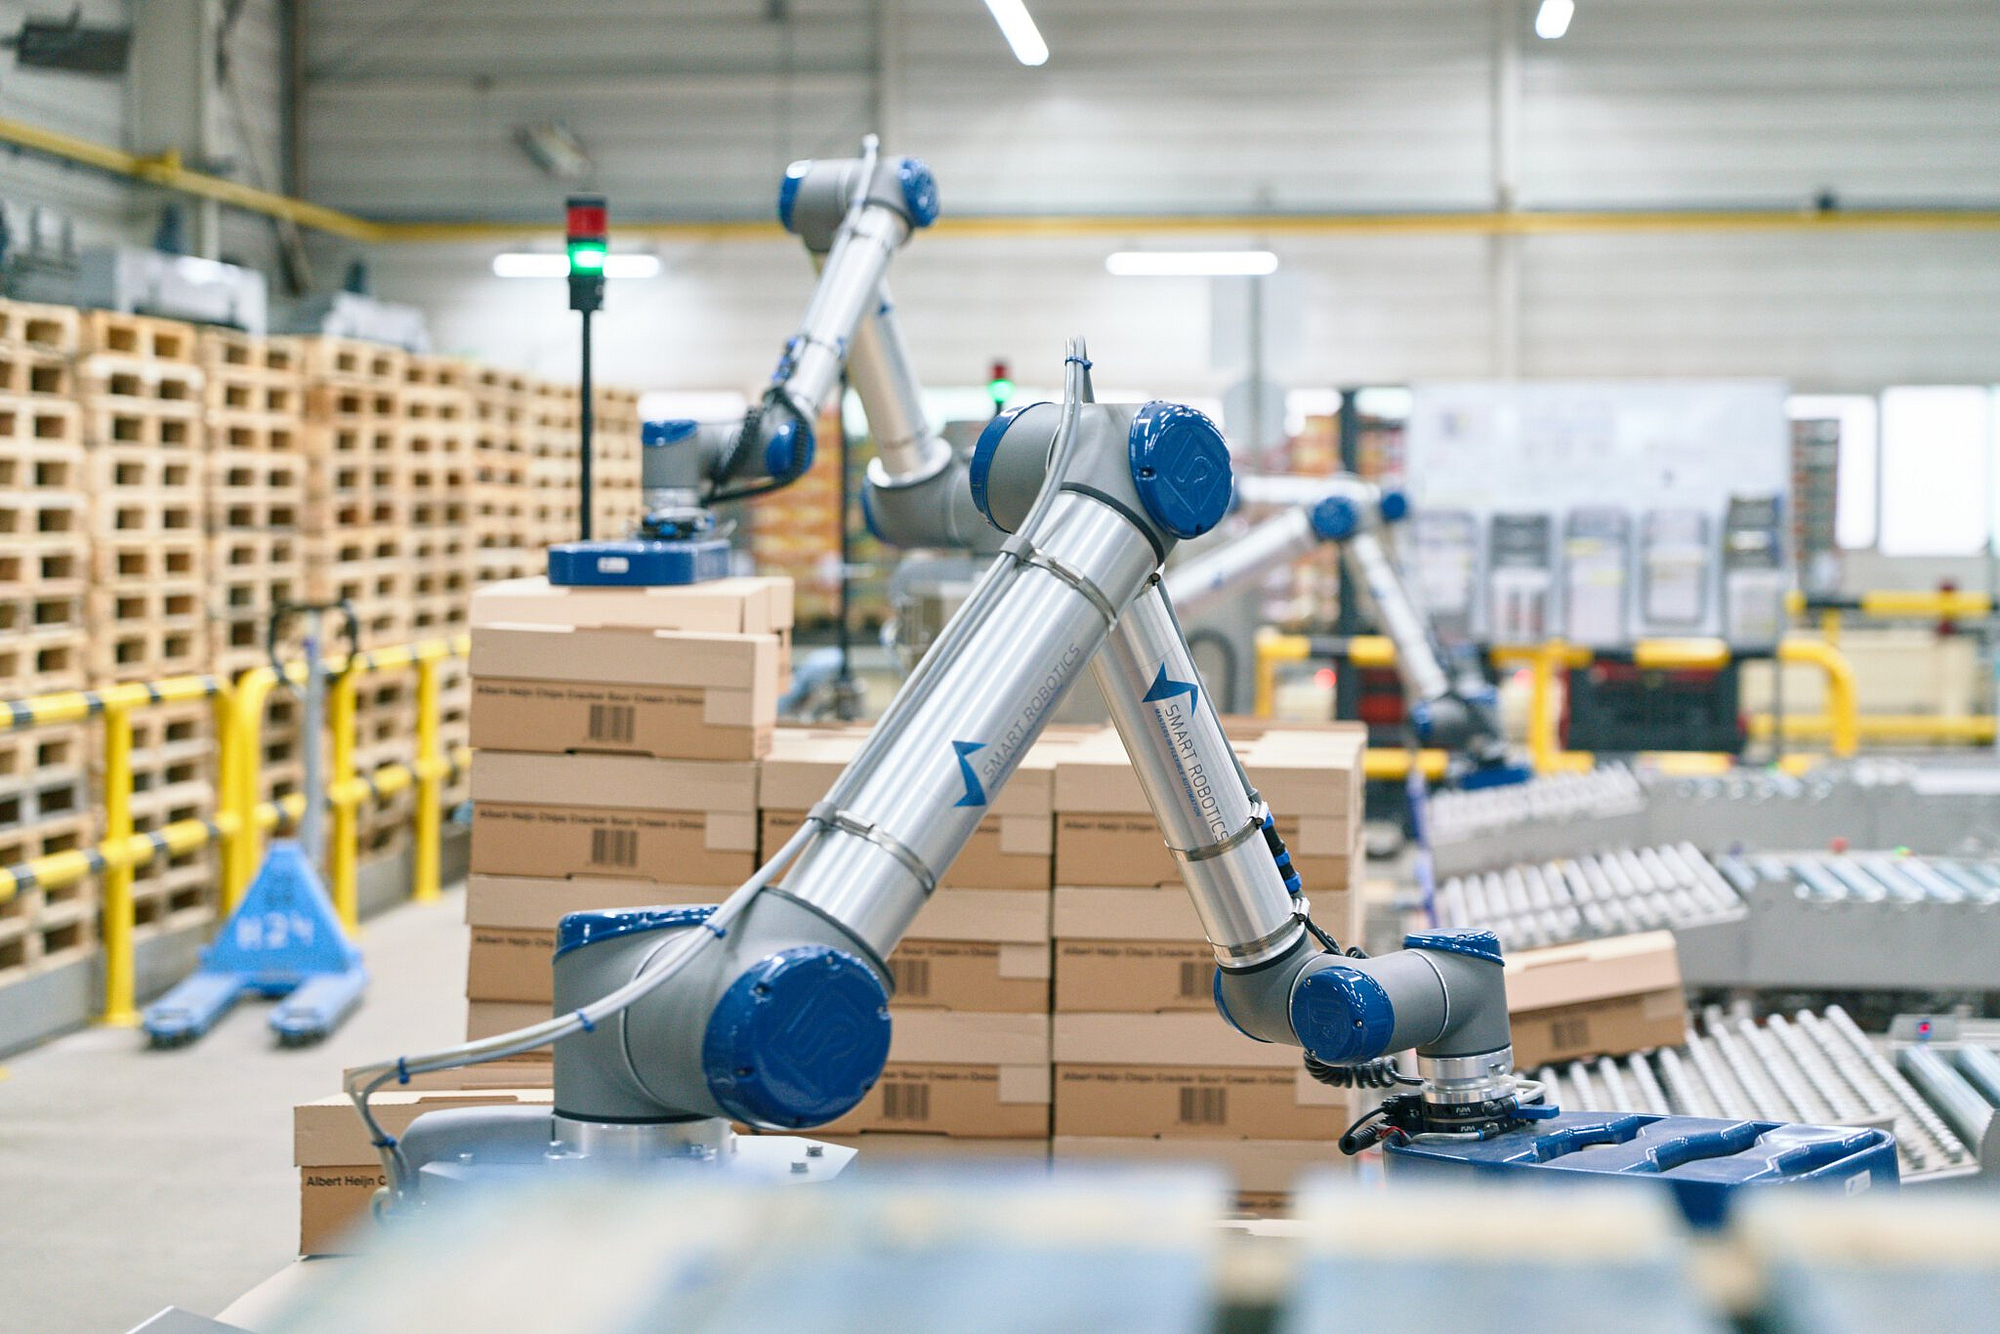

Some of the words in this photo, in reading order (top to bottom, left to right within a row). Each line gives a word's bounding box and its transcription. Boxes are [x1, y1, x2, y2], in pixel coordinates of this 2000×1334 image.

[984, 719, 1025, 780] SMART
[1024, 643, 1080, 723] ROBOTICS
[1165, 704, 1198, 760] SMART
[1189, 764, 1230, 843] ROBOTICS
[1169, 746, 1186, 777] FLEXIBLE
[1180, 776, 1202, 818] AUTOMATION
[306, 1175, 341, 1187] Albert
[344, 1174, 375, 1188] Heijn
